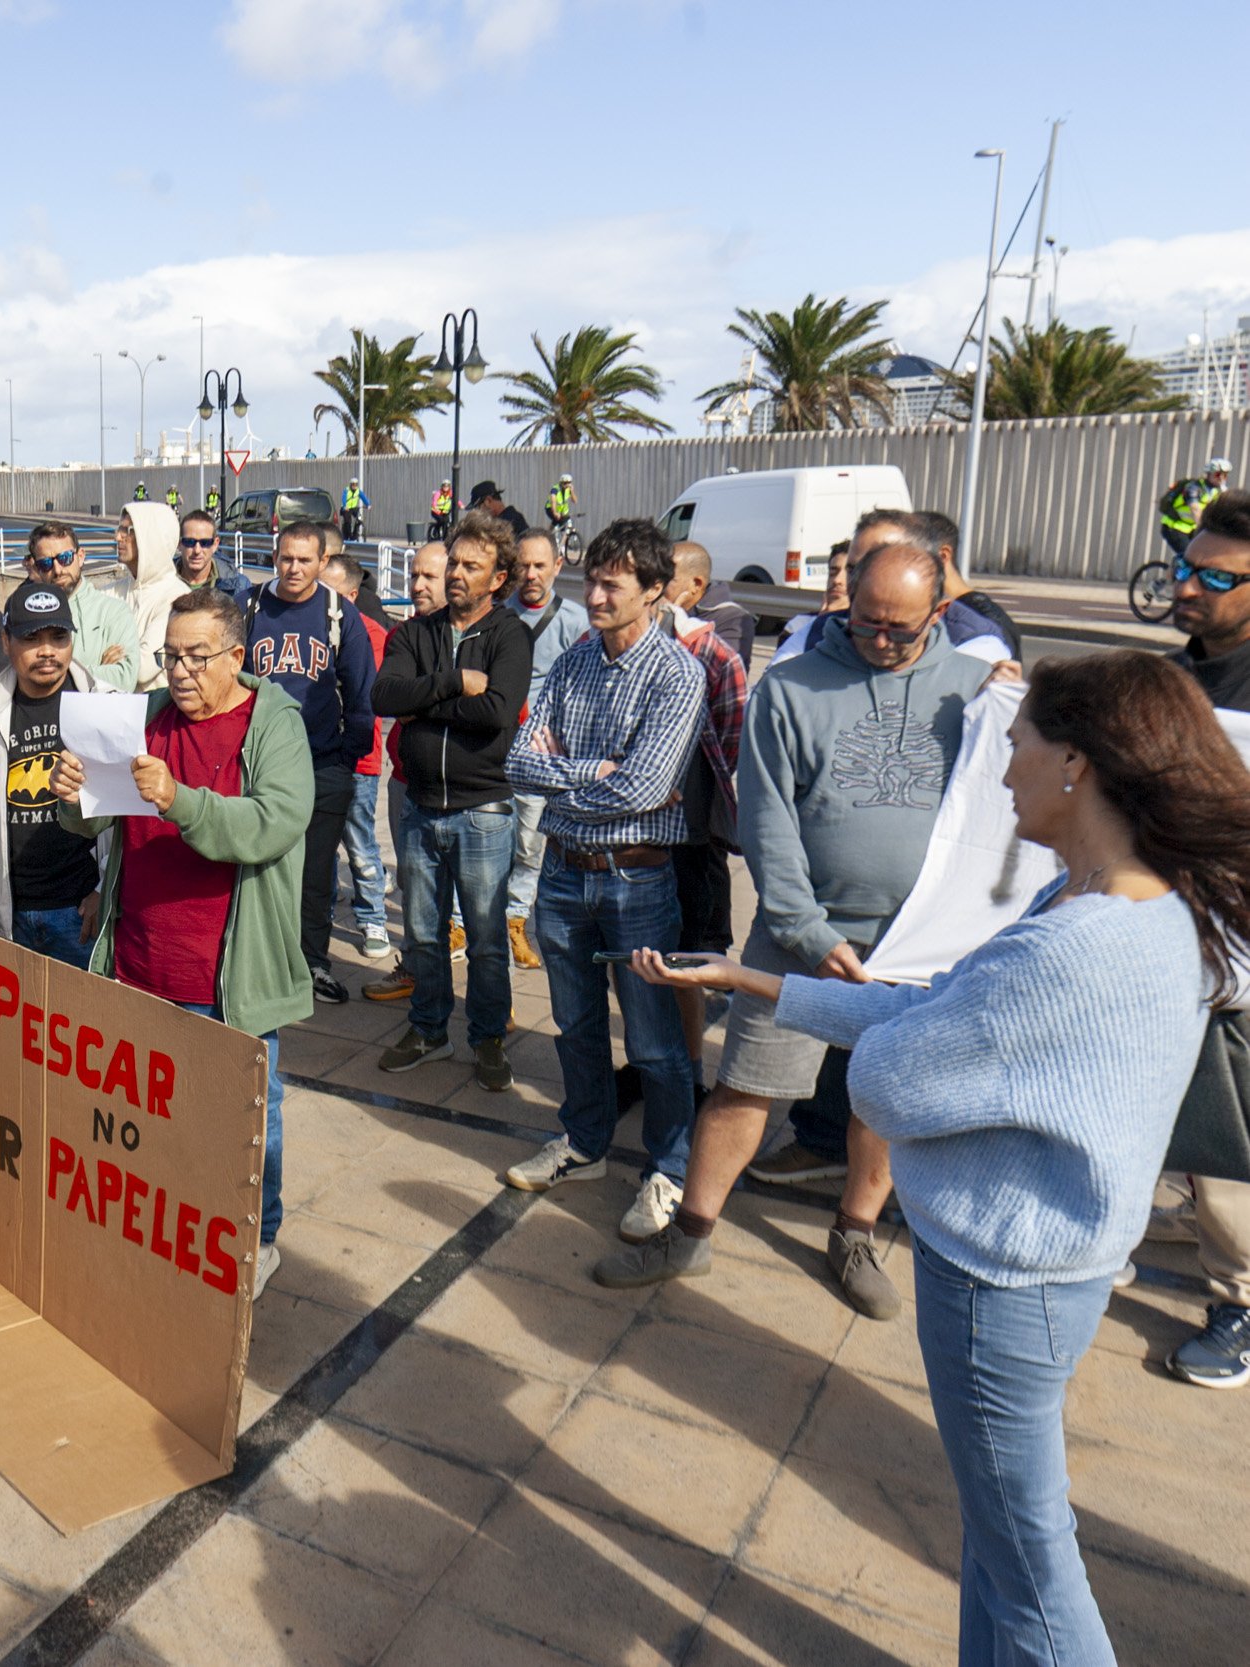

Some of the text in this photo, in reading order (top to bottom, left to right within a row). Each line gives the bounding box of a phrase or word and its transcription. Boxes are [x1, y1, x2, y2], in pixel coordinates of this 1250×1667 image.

[252, 632, 330, 682] GAP
[24, 724, 59, 742] ORIG
[7, 810, 59, 824] ATMA
[92, 1107, 141, 1153] NO
[47, 1137, 239, 1295] PAPELES
